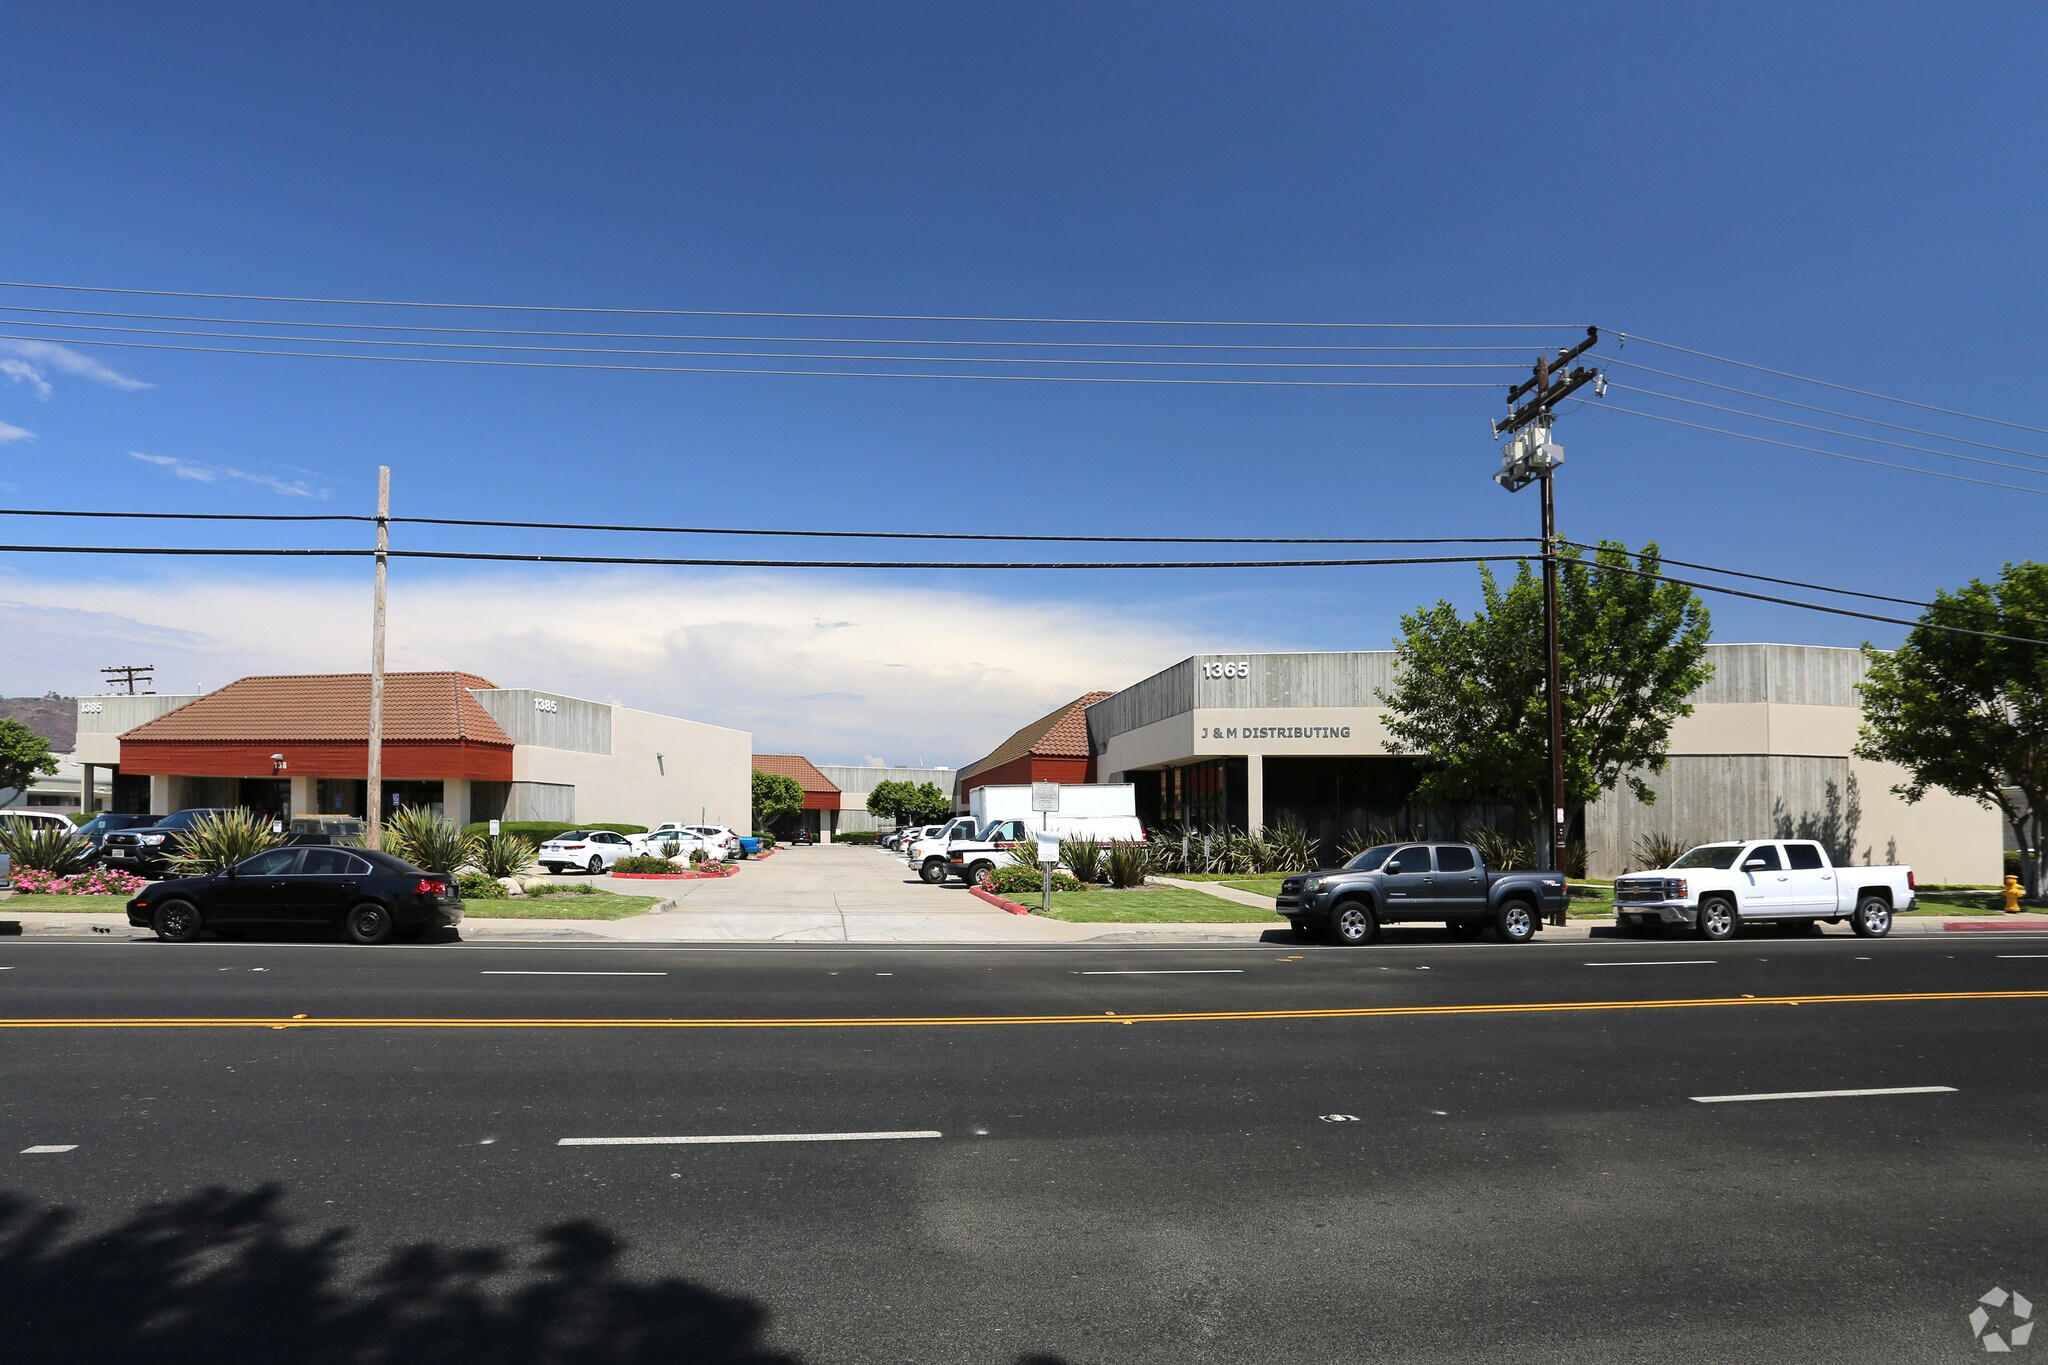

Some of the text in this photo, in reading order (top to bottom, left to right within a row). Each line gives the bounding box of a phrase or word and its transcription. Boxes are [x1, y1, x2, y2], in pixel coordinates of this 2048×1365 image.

[1203, 661, 1249, 679] 1365
[81, 702, 102, 713] 1385
[534, 697, 557, 713] 1385
[1202, 726, 1351, 739] J & M DISTRIBUTING
